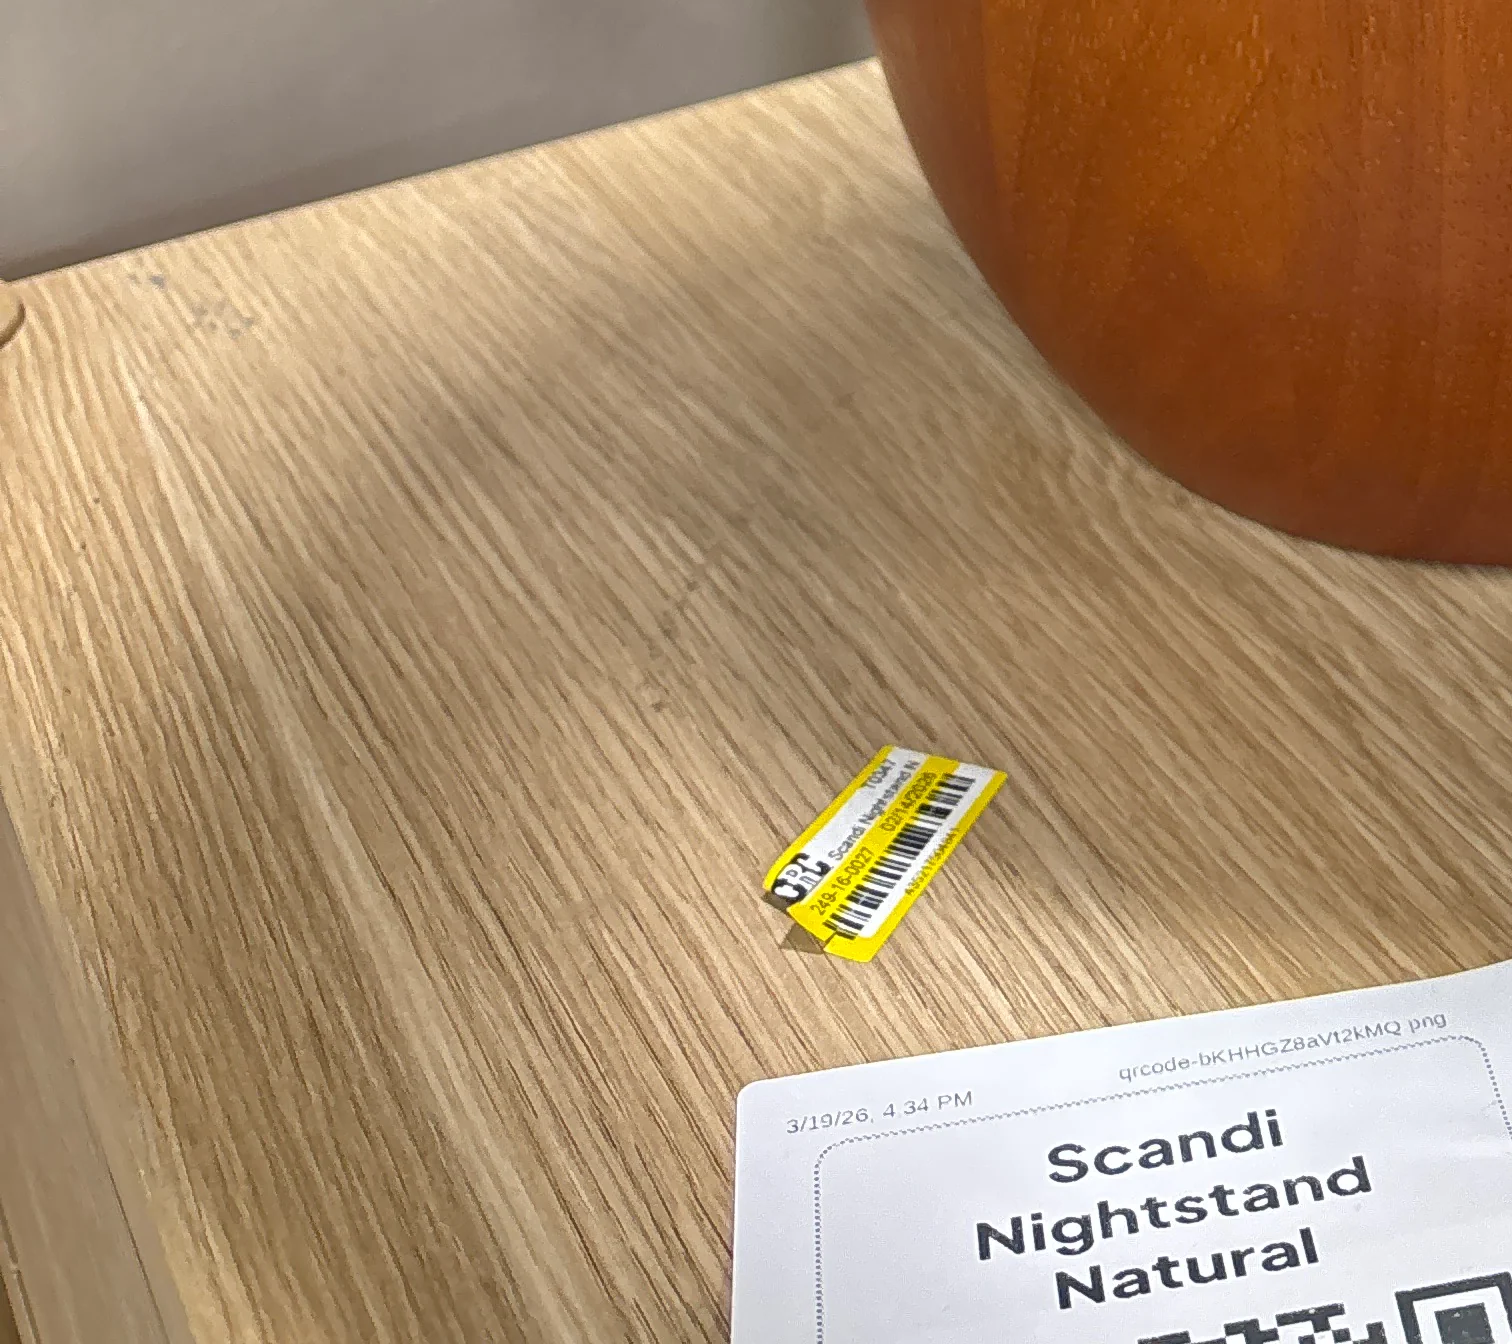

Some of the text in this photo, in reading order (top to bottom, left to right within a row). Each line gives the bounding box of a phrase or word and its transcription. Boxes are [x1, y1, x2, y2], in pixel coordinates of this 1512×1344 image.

[828, 824, 866, 861] Scandi
[810, 846, 875, 916] 249-16-0027
[786, 1091, 972, 1134] 3/19/26, 434 PM
[1047, 1108, 1284, 1184] Scandi
[976, 1156, 1372, 1261] Nightstand
[1055, 1227, 1319, 1310] Natural
